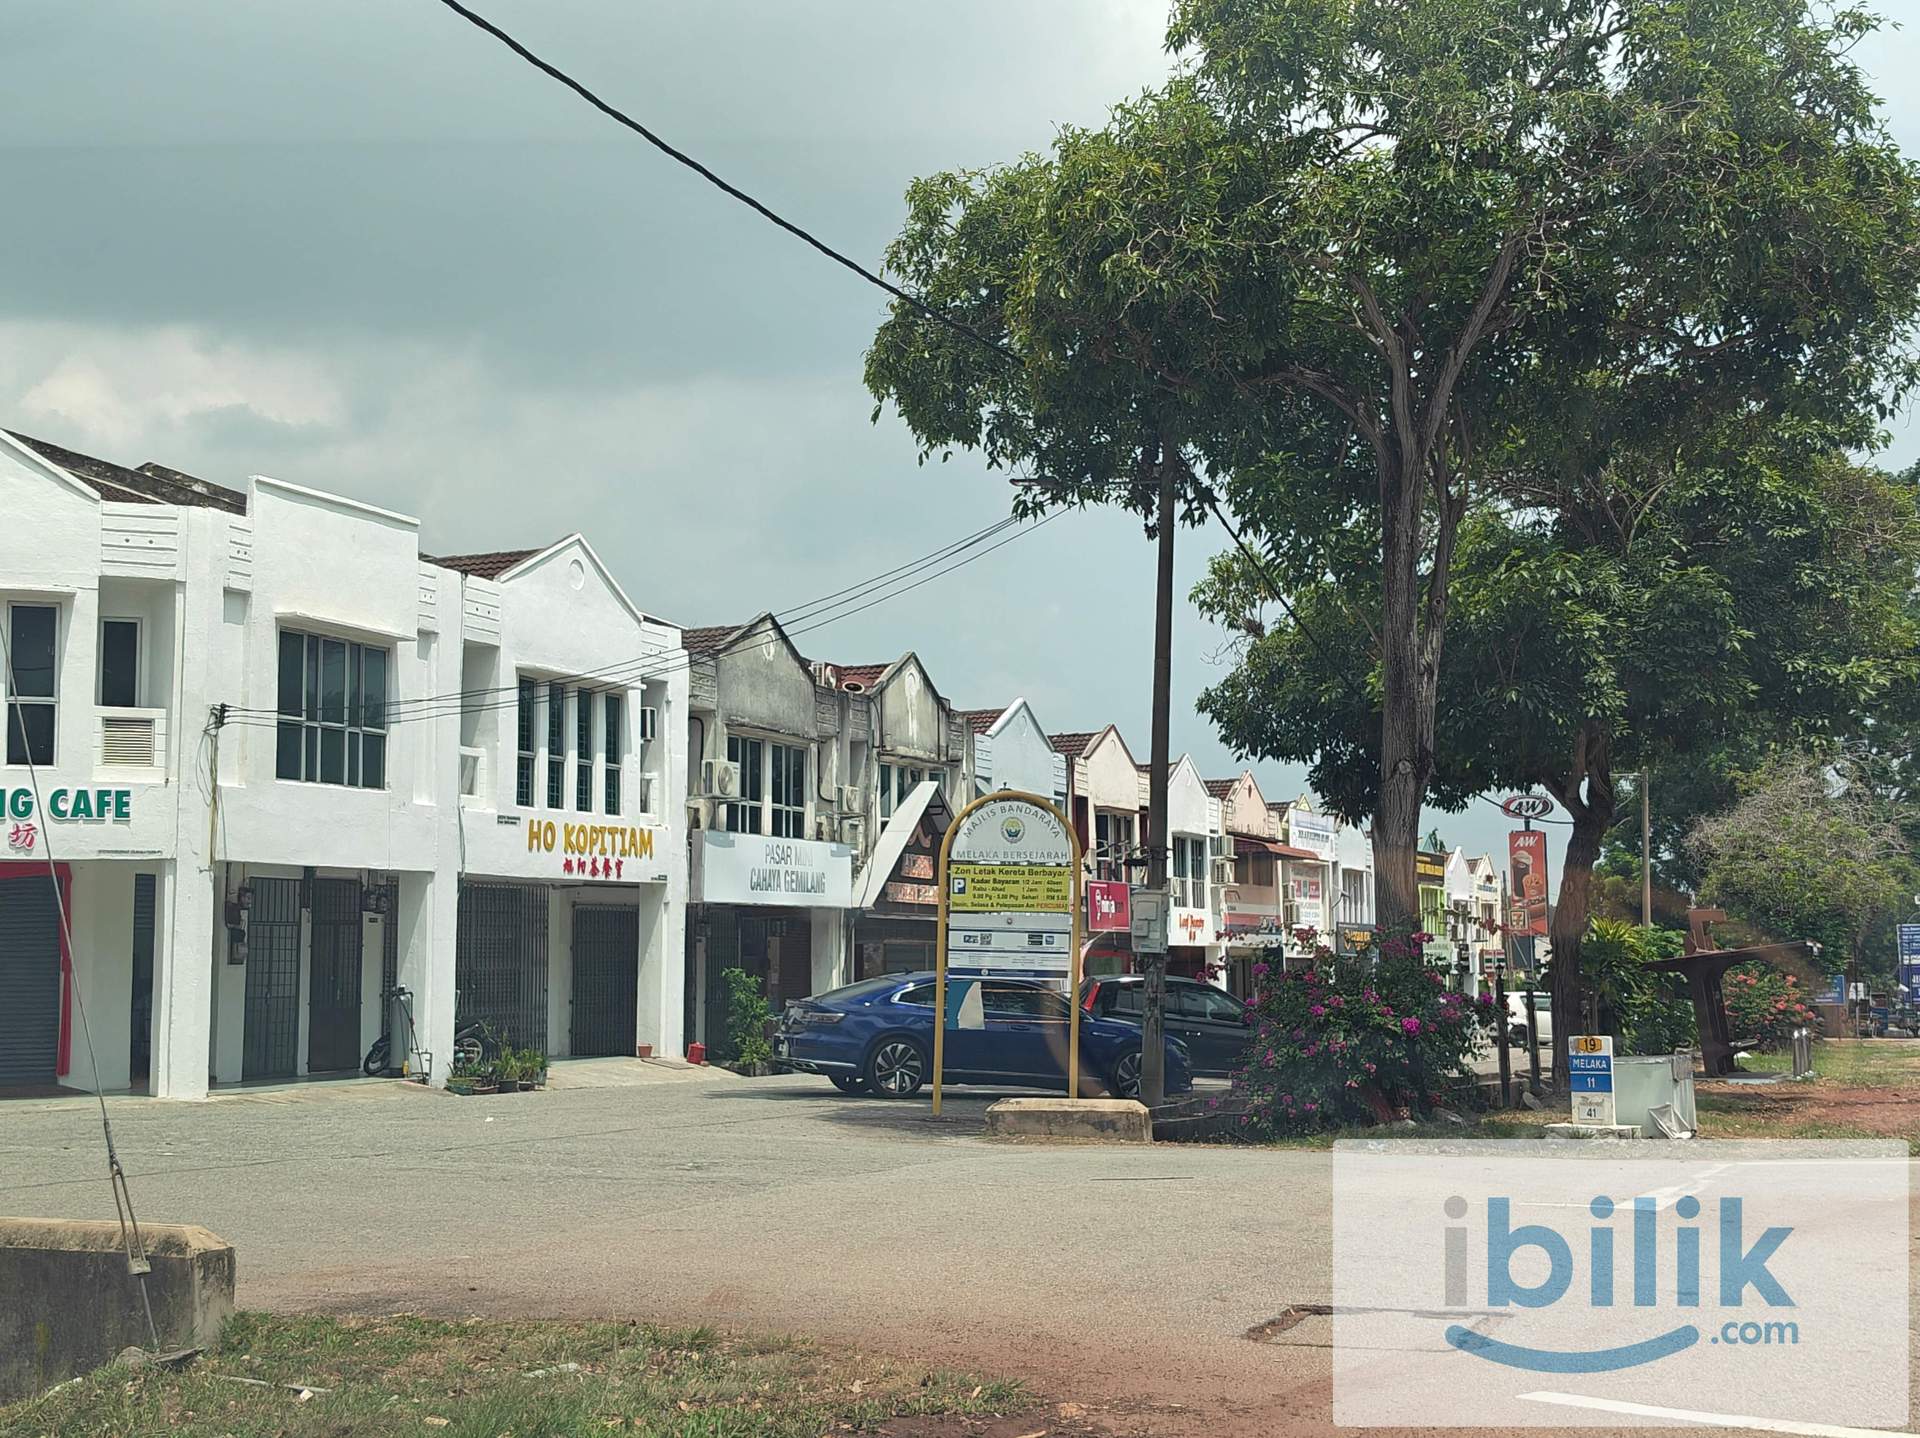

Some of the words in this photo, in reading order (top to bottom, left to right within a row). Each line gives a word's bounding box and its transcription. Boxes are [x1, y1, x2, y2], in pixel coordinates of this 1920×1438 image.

[49, 788, 131, 818] CAFE
[963, 808, 997, 838] MAJLIS
[1000, 804, 1061, 838] BANDARAYA
[9, 823, 38, 848] 坊
[528, 819, 556, 851] HO
[563, 822, 654, 860] KOPITIAM
[765, 844, 793, 865] PASAR
[956, 849, 999, 859] MELAKA
[1002, 850, 1068, 860] BERSEJARAH
[954, 867, 971, 875] Zon
[973, 867, 996, 875] Letak
[998, 868, 1026, 876] Kereta
[1028, 868, 1066, 878] Berbayar
[750, 868, 782, 892] CAHAYA
[784, 870, 826, 894] GEMILANG
[992, 878, 1020, 886] Bayaran
[1584, 1038, 1596, 1050] 19
[1572, 1058, 1607, 1069] MELAKA
[1586, 1077, 1596, 1088] 11
[1586, 1108, 1597, 1118] 41
